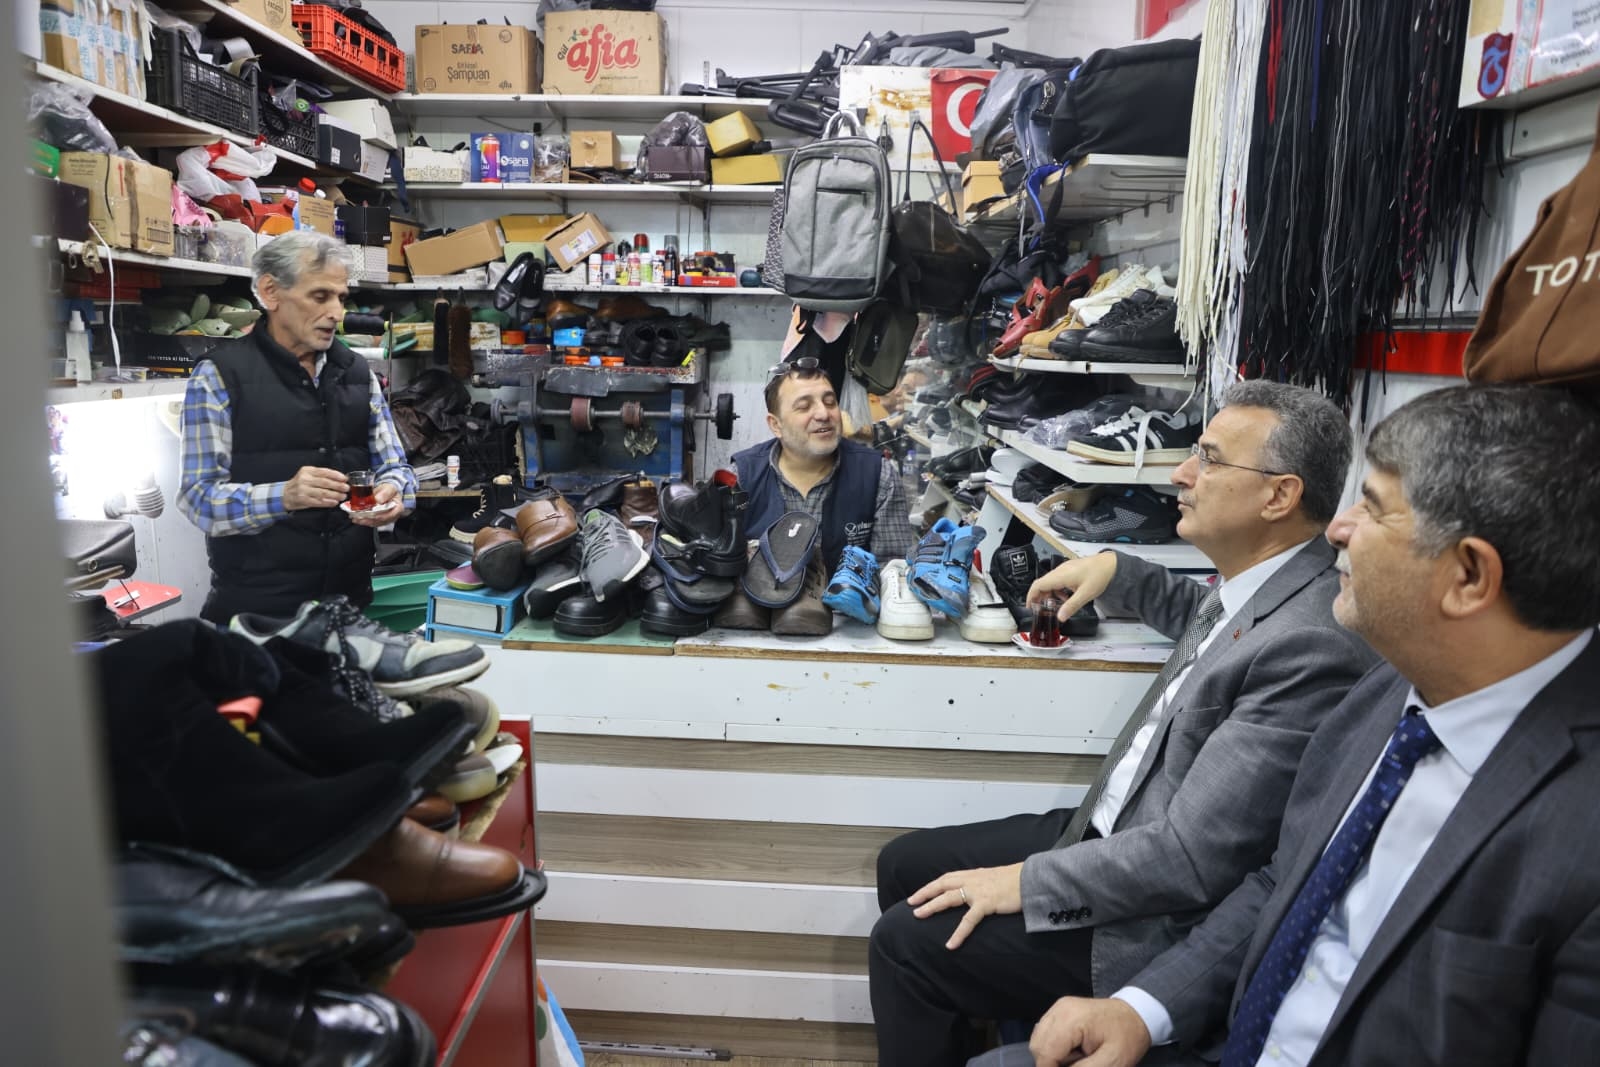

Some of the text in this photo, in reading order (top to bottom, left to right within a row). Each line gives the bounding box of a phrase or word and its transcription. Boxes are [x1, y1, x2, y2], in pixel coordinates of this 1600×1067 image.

[447, 66, 490, 84] Şampuan
[567, 23, 640, 83] afia
[1526, 250, 1600, 296] TOT
